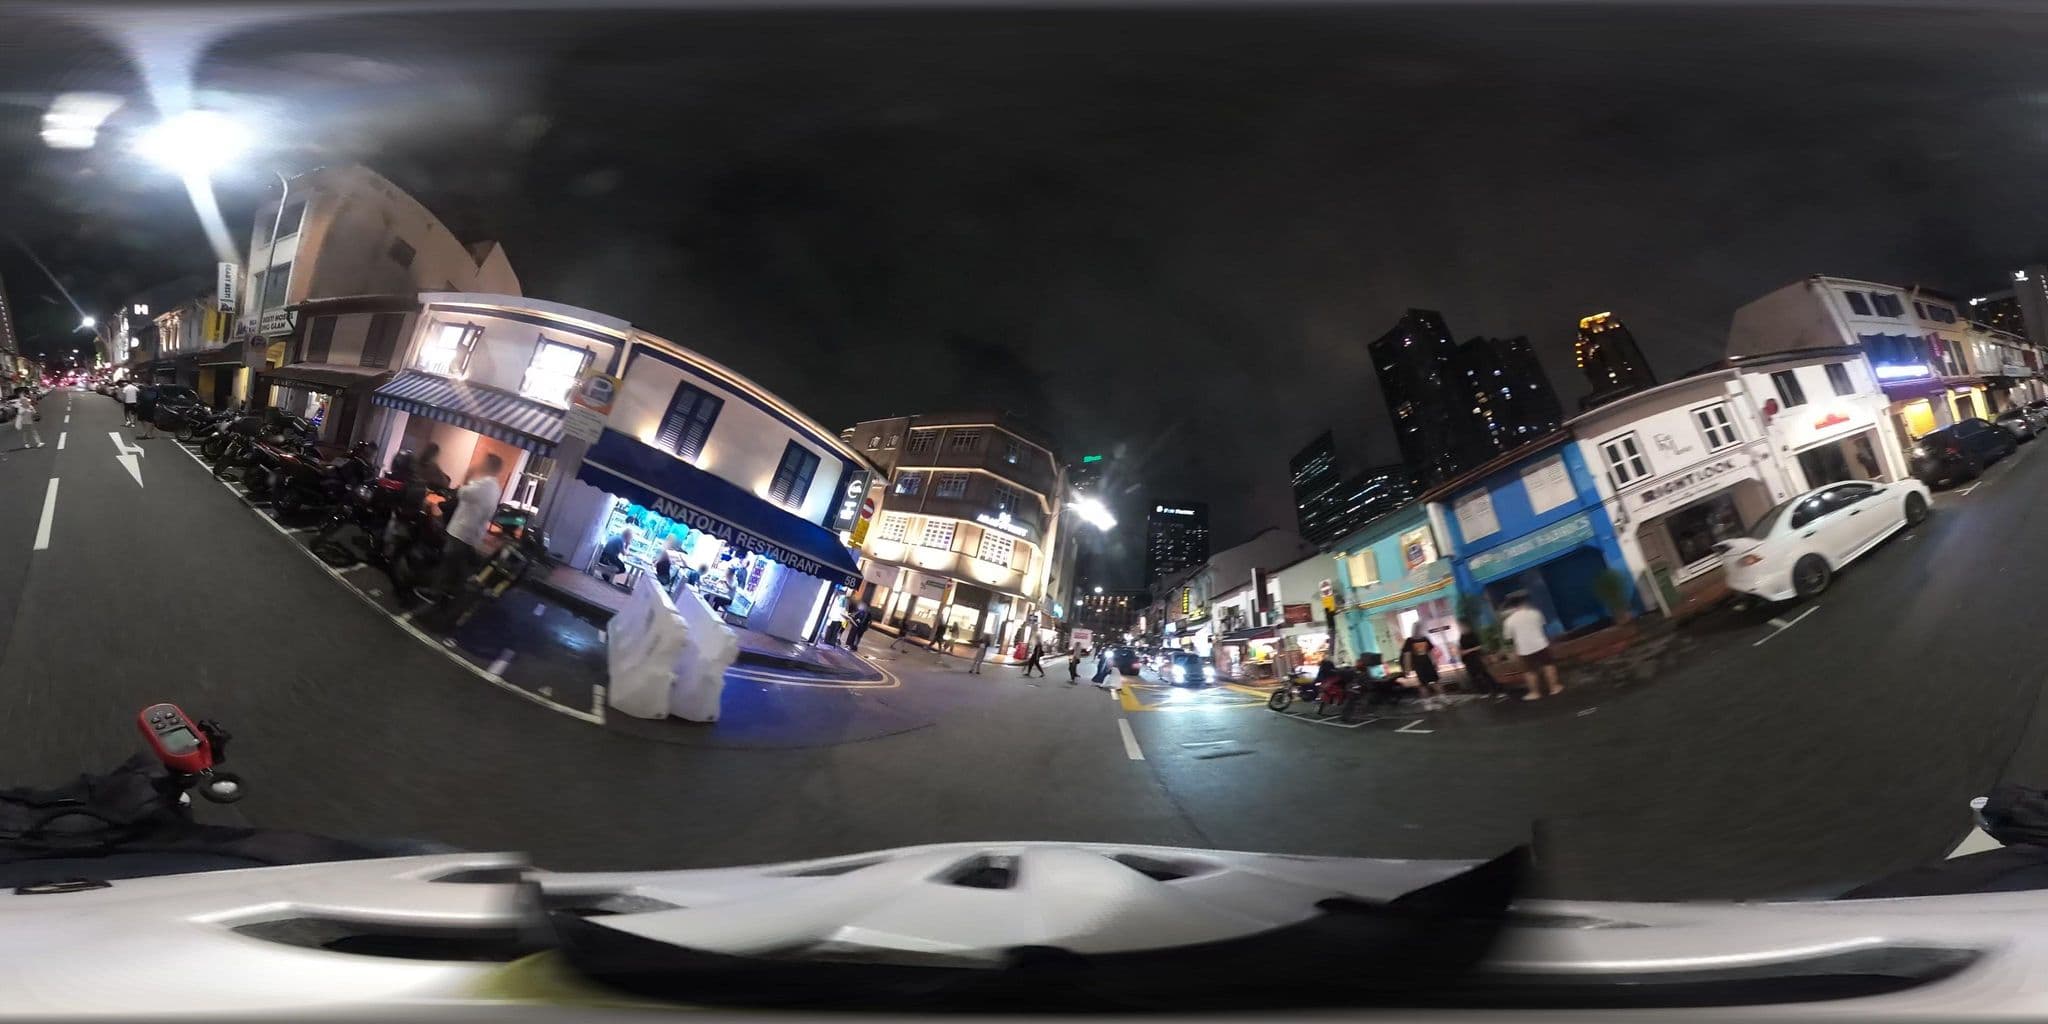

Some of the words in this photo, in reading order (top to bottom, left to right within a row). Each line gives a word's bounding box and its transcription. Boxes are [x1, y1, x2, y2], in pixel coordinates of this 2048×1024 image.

[1641, 472, 1695, 503] RIGHT
[1697, 459, 1736, 481] LOOK
[651, 498, 733, 540] ANATOLIA
[735, 532, 822, 577] RESTAURANT
[843, 575, 857, 588] 58
